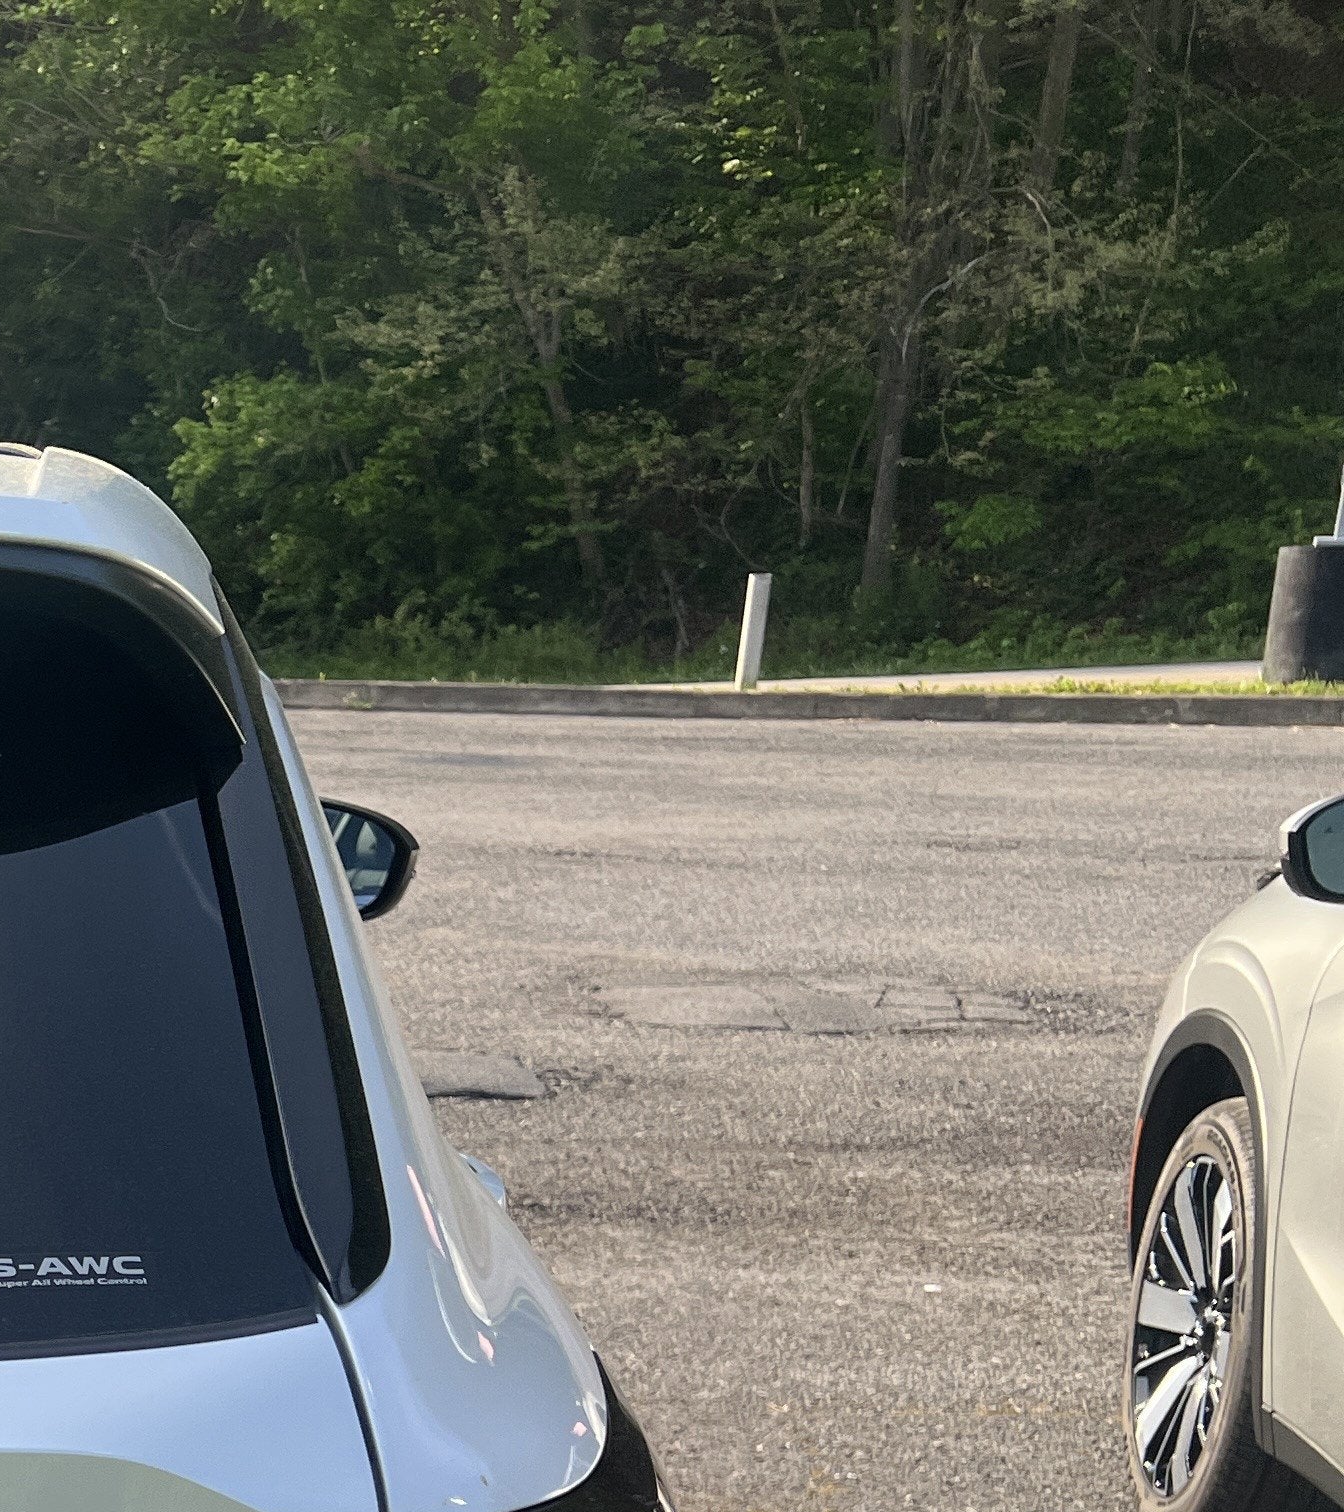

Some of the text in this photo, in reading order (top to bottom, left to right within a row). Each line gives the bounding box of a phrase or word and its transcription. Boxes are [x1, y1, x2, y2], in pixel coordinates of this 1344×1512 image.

[31, 1279, 51, 1287] All
[53, 1278, 95, 1286] Wheel
[97, 1277, 148, 1285] Control
